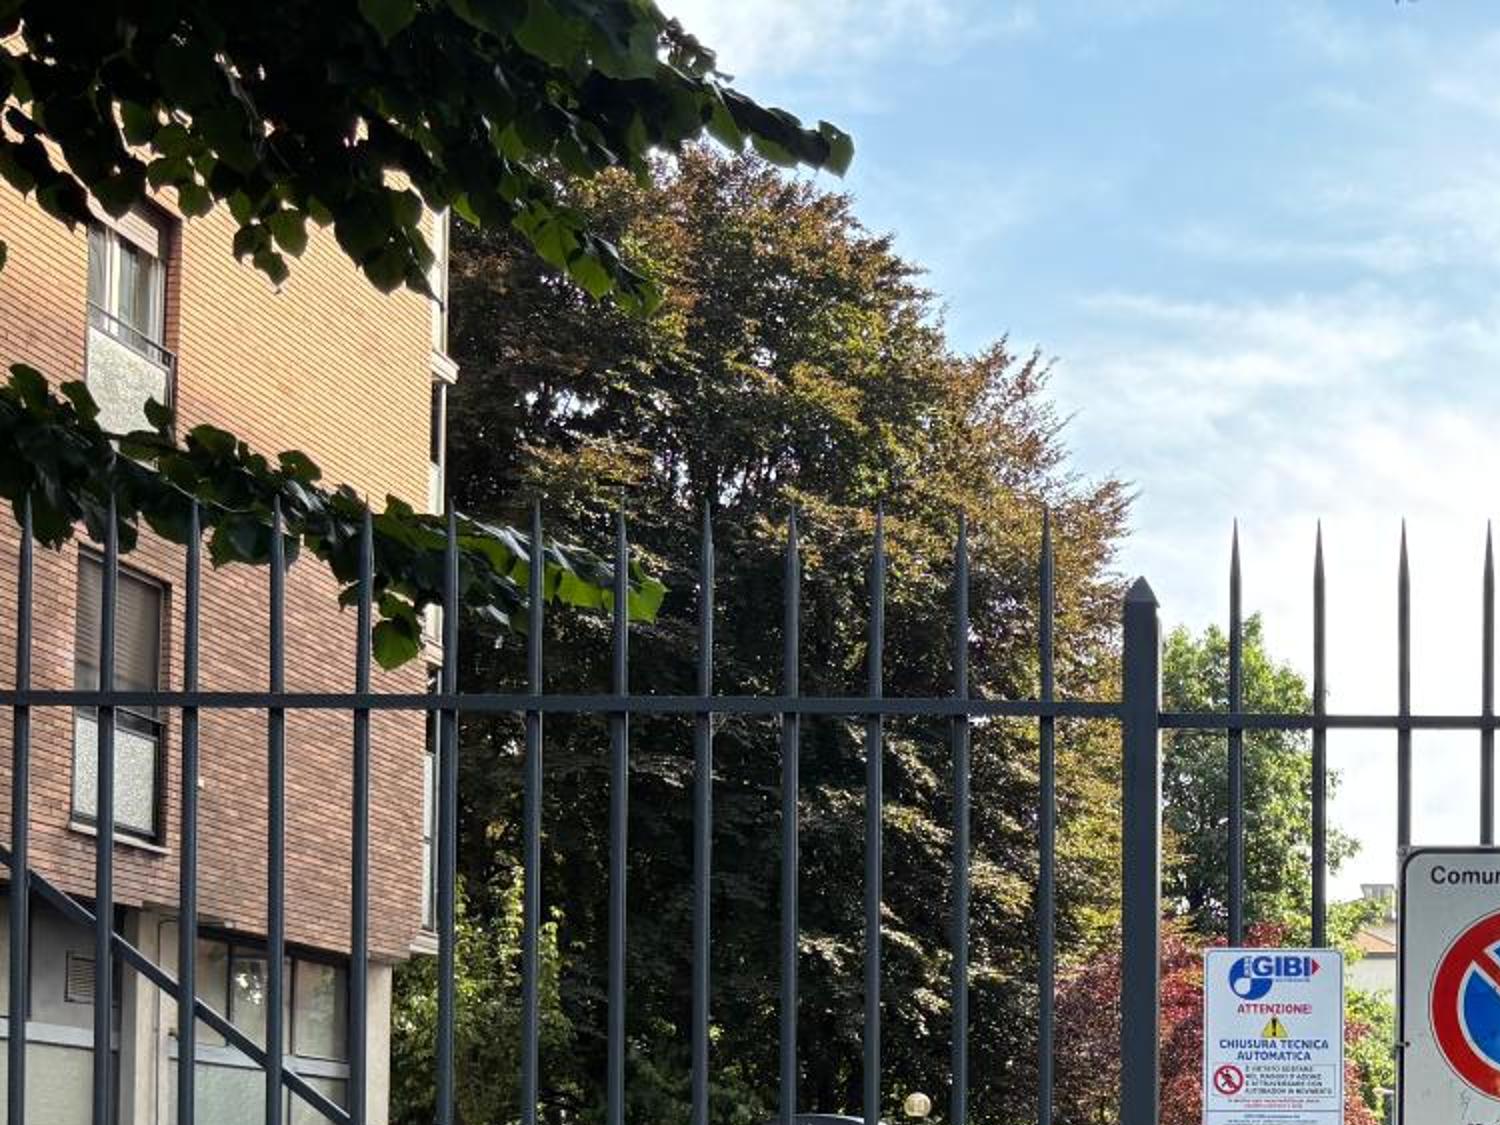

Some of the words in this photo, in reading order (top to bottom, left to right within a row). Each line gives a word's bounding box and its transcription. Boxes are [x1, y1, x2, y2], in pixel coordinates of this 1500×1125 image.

[1252, 955, 1311, 977] GIBI
[1219, 1039, 1277, 1049] CHIUSURA
[1280, 1039, 1329, 1049] TECNICA
[1237, 1050, 1312, 1061] AUTOMATICA
